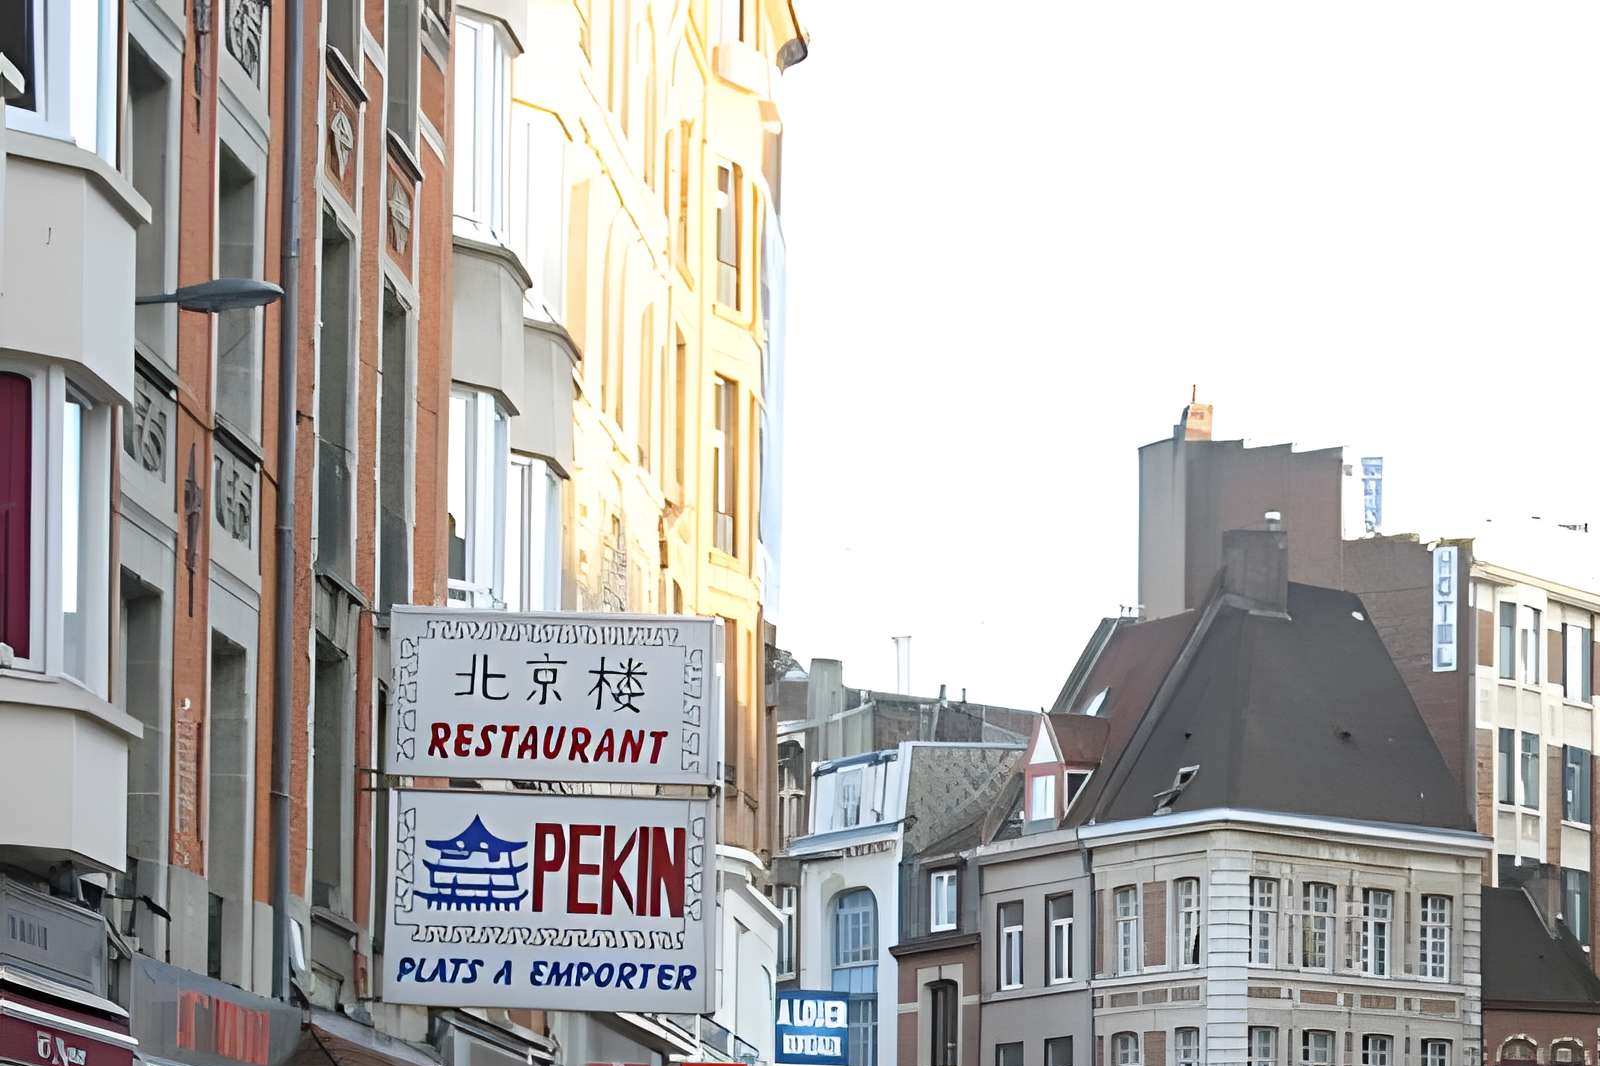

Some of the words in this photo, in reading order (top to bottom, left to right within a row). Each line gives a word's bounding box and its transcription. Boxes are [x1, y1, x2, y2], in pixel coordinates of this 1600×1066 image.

[454, 652, 648, 714] 北京楼
[427, 721, 669, 765] RESTAURANT
[531, 822, 686, 918] PEKIN
[396, 956, 484, 984] PLATS
[529, 960, 698, 991] EMPORTER
